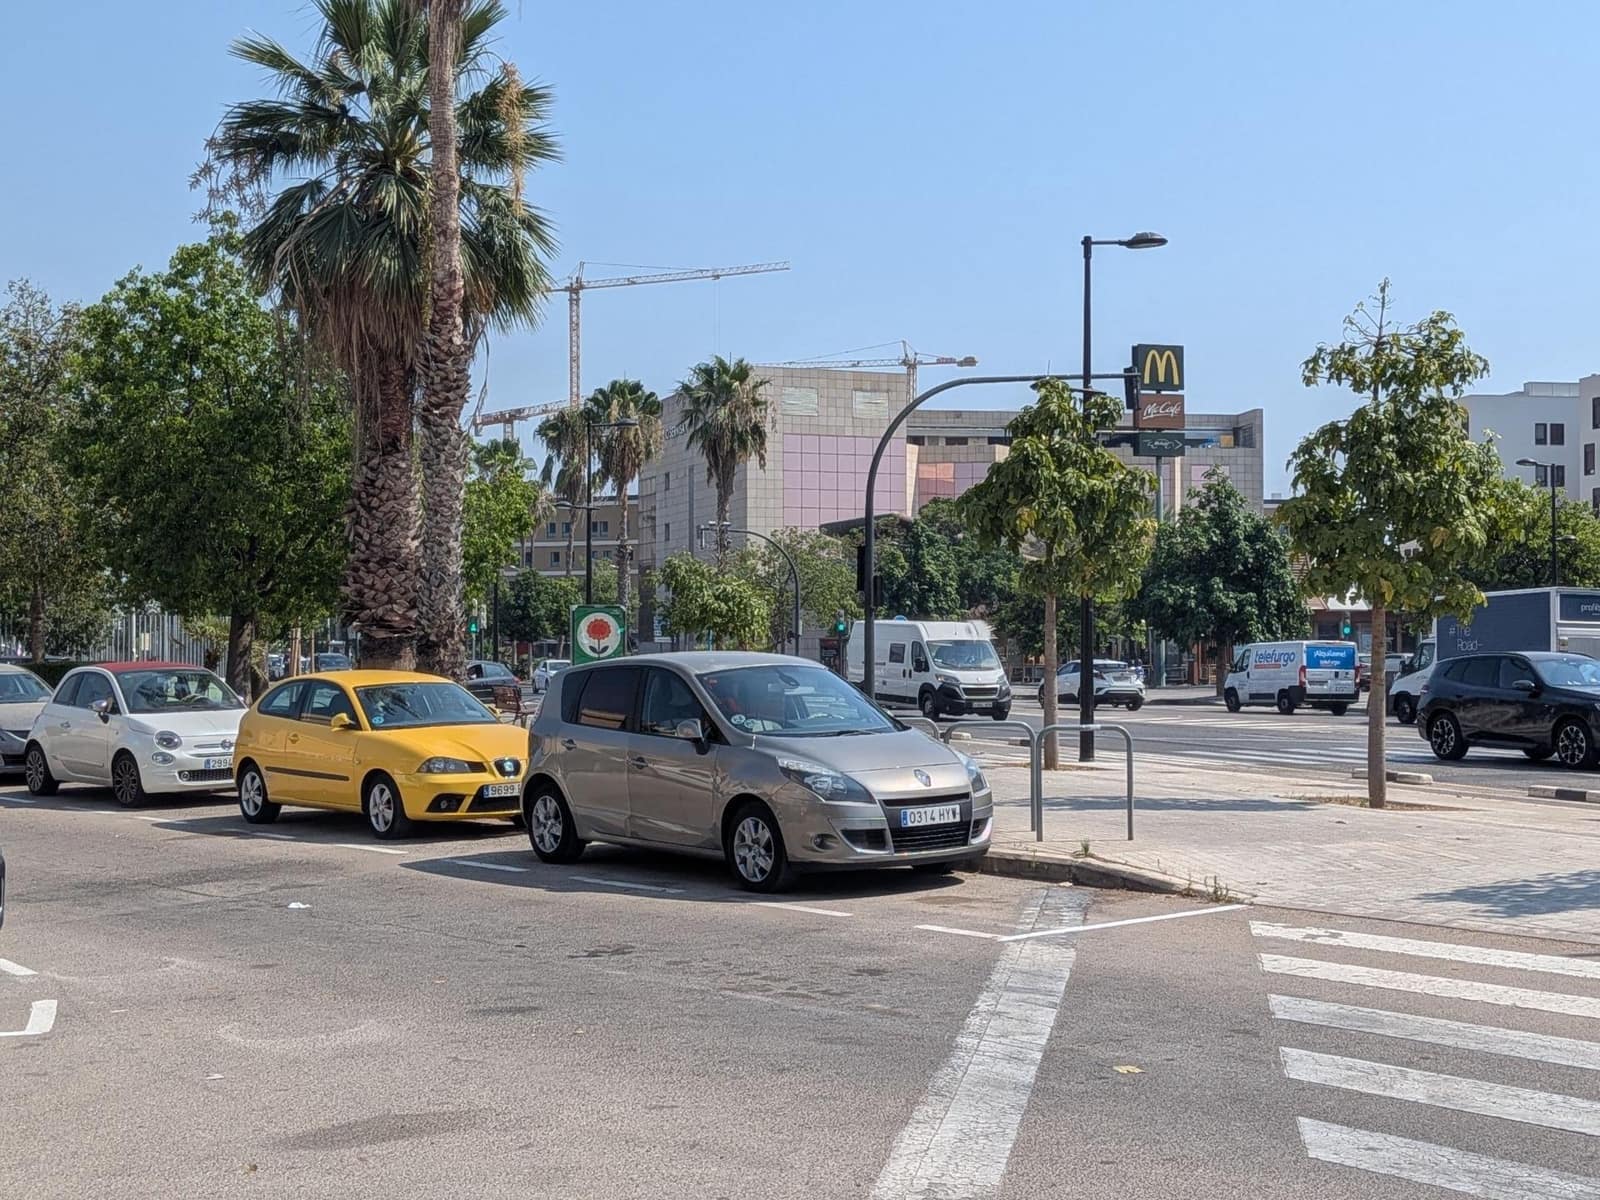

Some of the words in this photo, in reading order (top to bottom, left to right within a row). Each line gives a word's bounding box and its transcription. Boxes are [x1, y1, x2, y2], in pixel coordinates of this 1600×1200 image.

[1143, 349, 1180, 385] M
[1254, 649, 1296, 668] telefurgo
[490, 784, 515, 796] 9699
[909, 809, 936, 824] 0314
